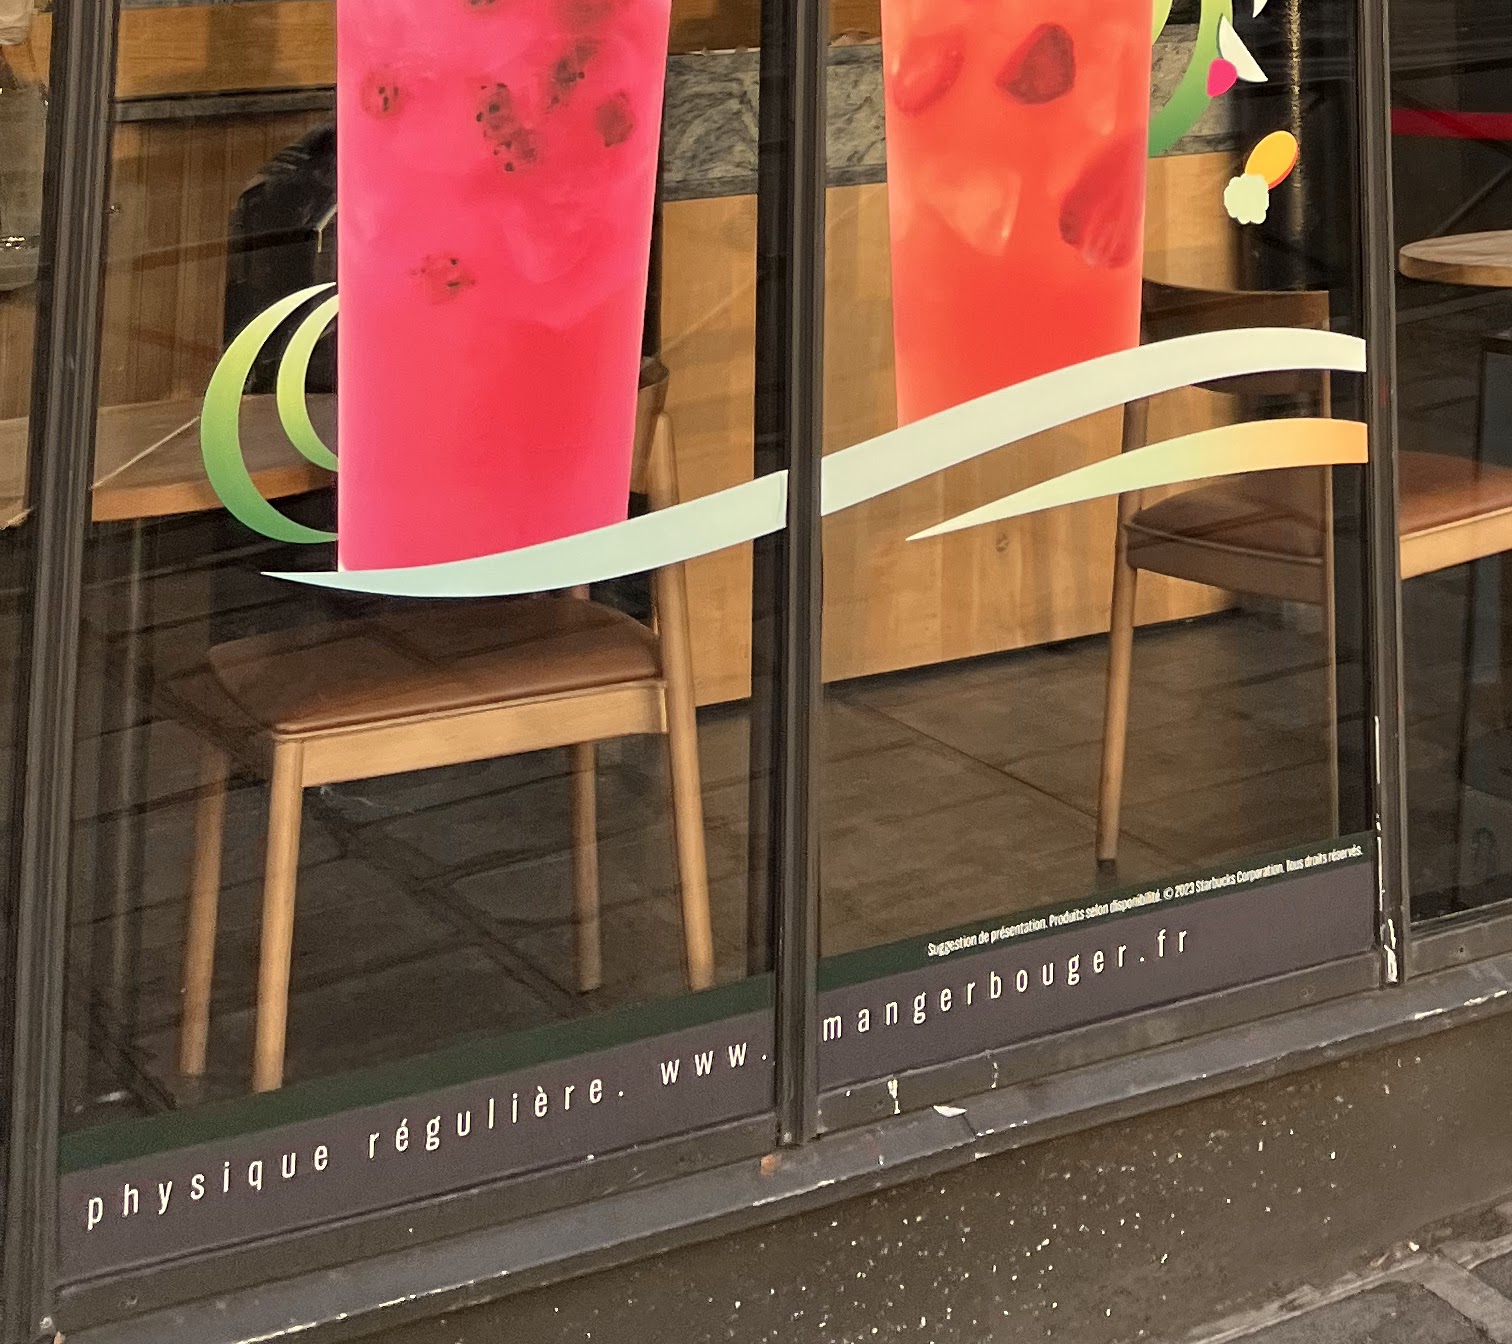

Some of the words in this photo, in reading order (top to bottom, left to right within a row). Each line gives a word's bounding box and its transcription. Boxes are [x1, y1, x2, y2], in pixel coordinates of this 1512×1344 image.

[927, 933, 977, 957] Suggestion
[978, 930, 990, 945] de
[990, 917, 1048, 943] présentation.
[1049, 908, 1085, 928] Produits
[1085, 903, 1109, 919] selon
[1175, 880, 1195, 898] 2023
[1195, 872, 1236, 893] Starbucks
[1285, 857, 1304, 872] Tous
[1304, 852, 1328, 868] droits
[86, 1143, 329, 1231] physique
[367, 1076, 625, 1160] régulière.
[822, 928, 1187, 1041] mangerbouger.fr
